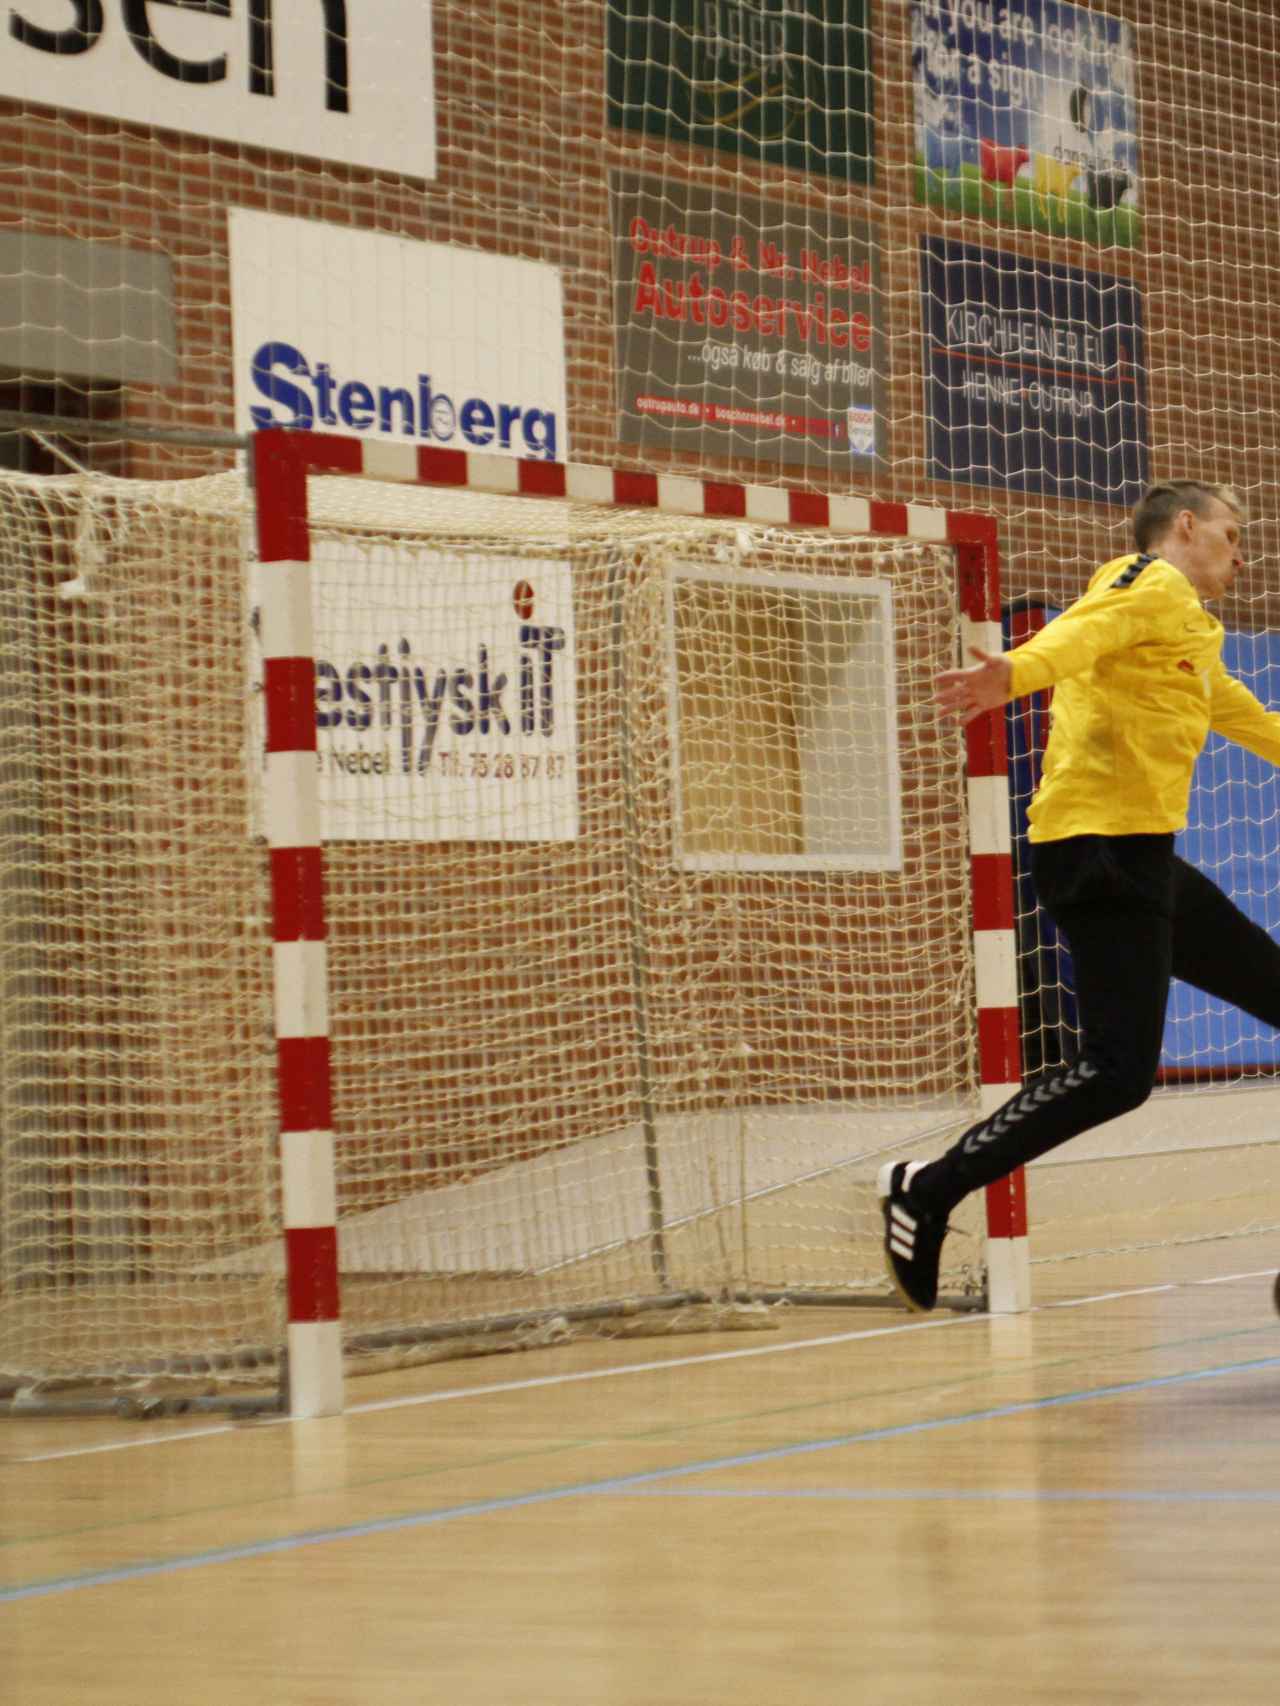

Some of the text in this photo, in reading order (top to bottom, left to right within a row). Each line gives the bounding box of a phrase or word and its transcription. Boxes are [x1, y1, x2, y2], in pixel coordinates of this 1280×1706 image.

[630, 216, 721, 272] Outrup
[634, 261, 873, 352] Autoservice
[250, 341, 556, 462] Stenberg
